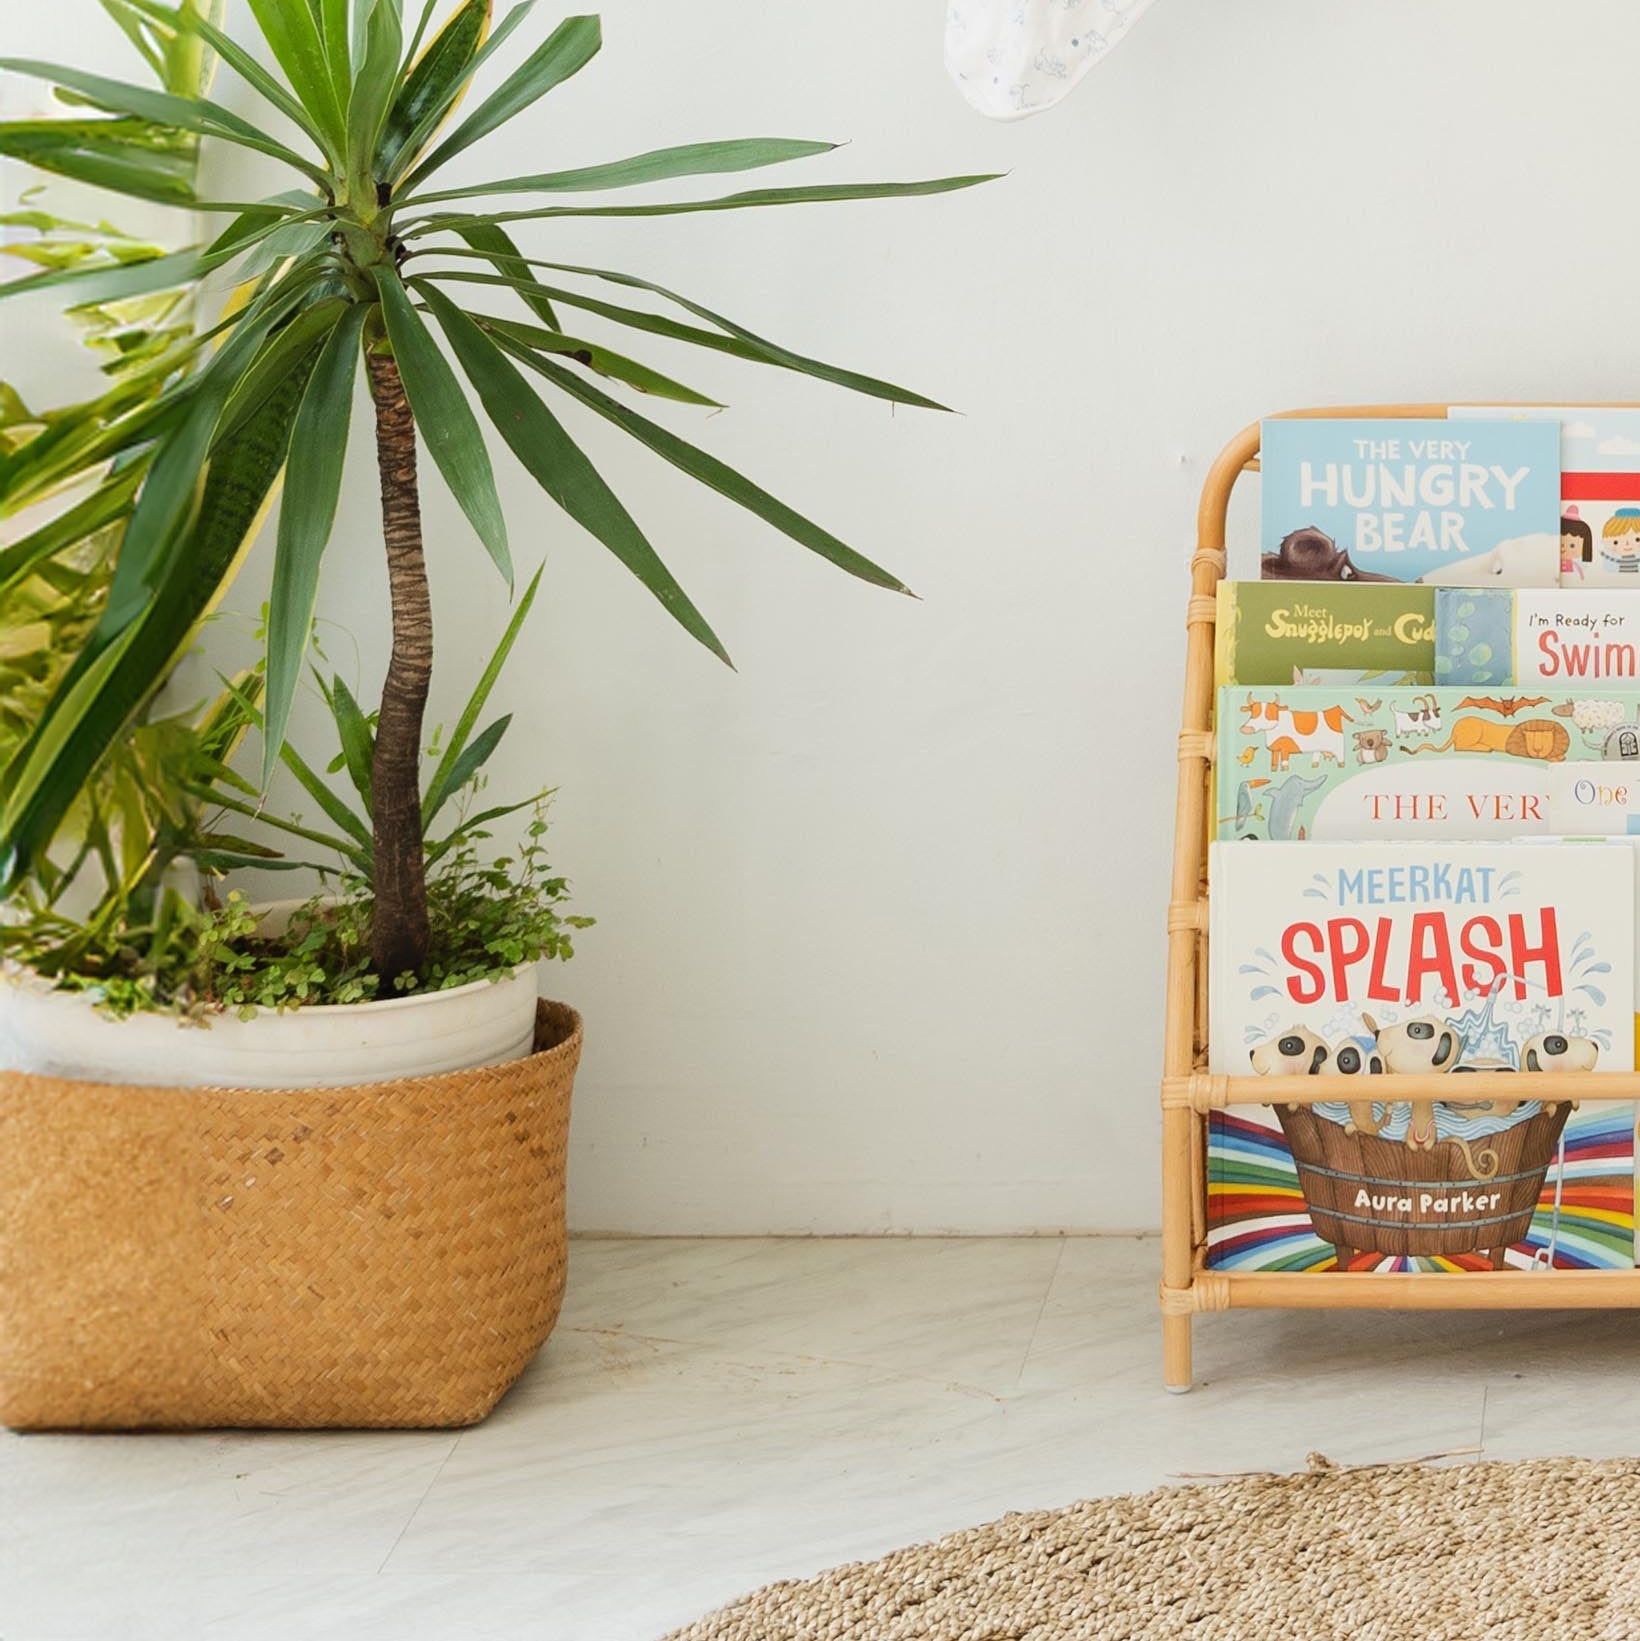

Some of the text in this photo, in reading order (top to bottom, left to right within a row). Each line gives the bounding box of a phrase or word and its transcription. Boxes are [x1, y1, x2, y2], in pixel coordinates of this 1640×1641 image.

[1354, 440, 1471, 459] THE VERY
[1300, 462, 1530, 511] HUNGRY
[1355, 511, 1470, 552] BEAR
[1294, 604, 1327, 618] Meet
[1529, 613, 1625, 631] I'm Ready for
[1265, 609, 1373, 645] Snugglepot
[1374, 626, 1392, 636] and
[1574, 778, 1629, 805] One
[1364, 794, 1550, 820] THE VER
[1338, 863, 1496, 906] MEERKAT
[1281, 907, 1564, 1009] SPLASH
[1354, 1190, 1501, 1214] Aura Parker
